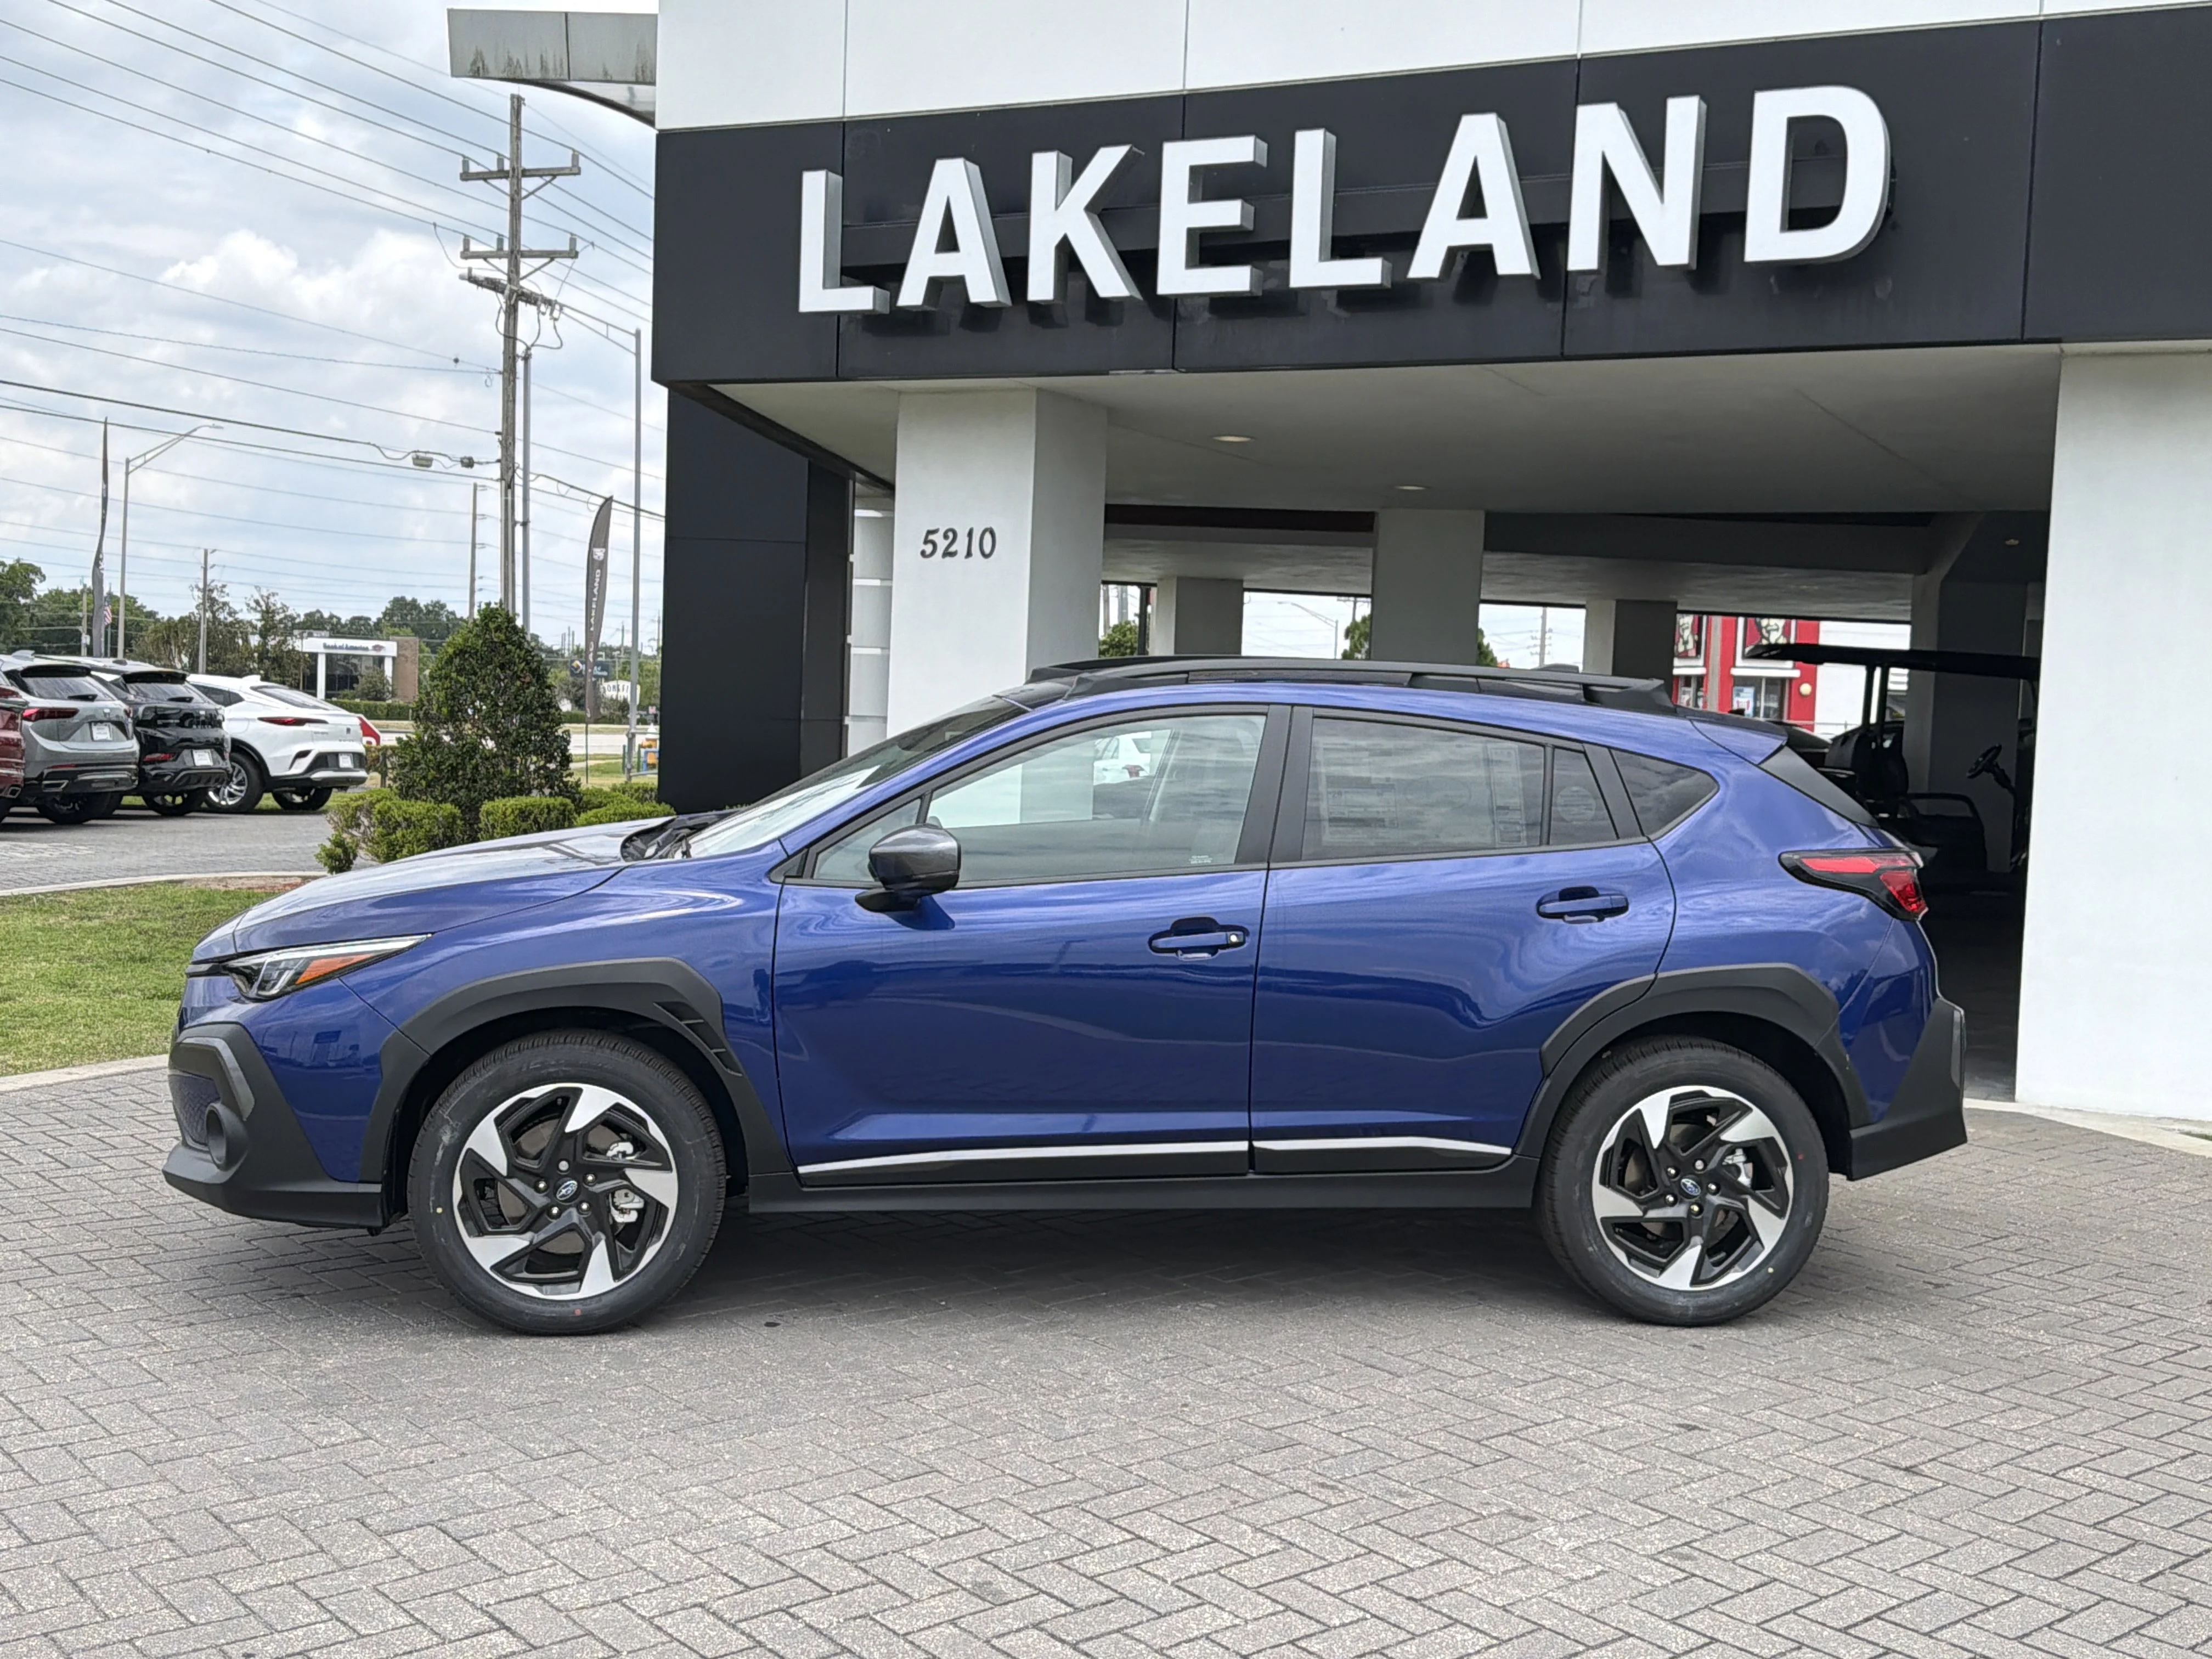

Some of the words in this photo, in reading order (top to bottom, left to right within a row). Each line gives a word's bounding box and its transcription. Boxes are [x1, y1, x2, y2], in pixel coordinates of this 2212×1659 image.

[798, 85, 1891, 314] LAKELAND
[920, 526, 996, 559] 5210
[590, 569, 601, 631] LAKELAND
